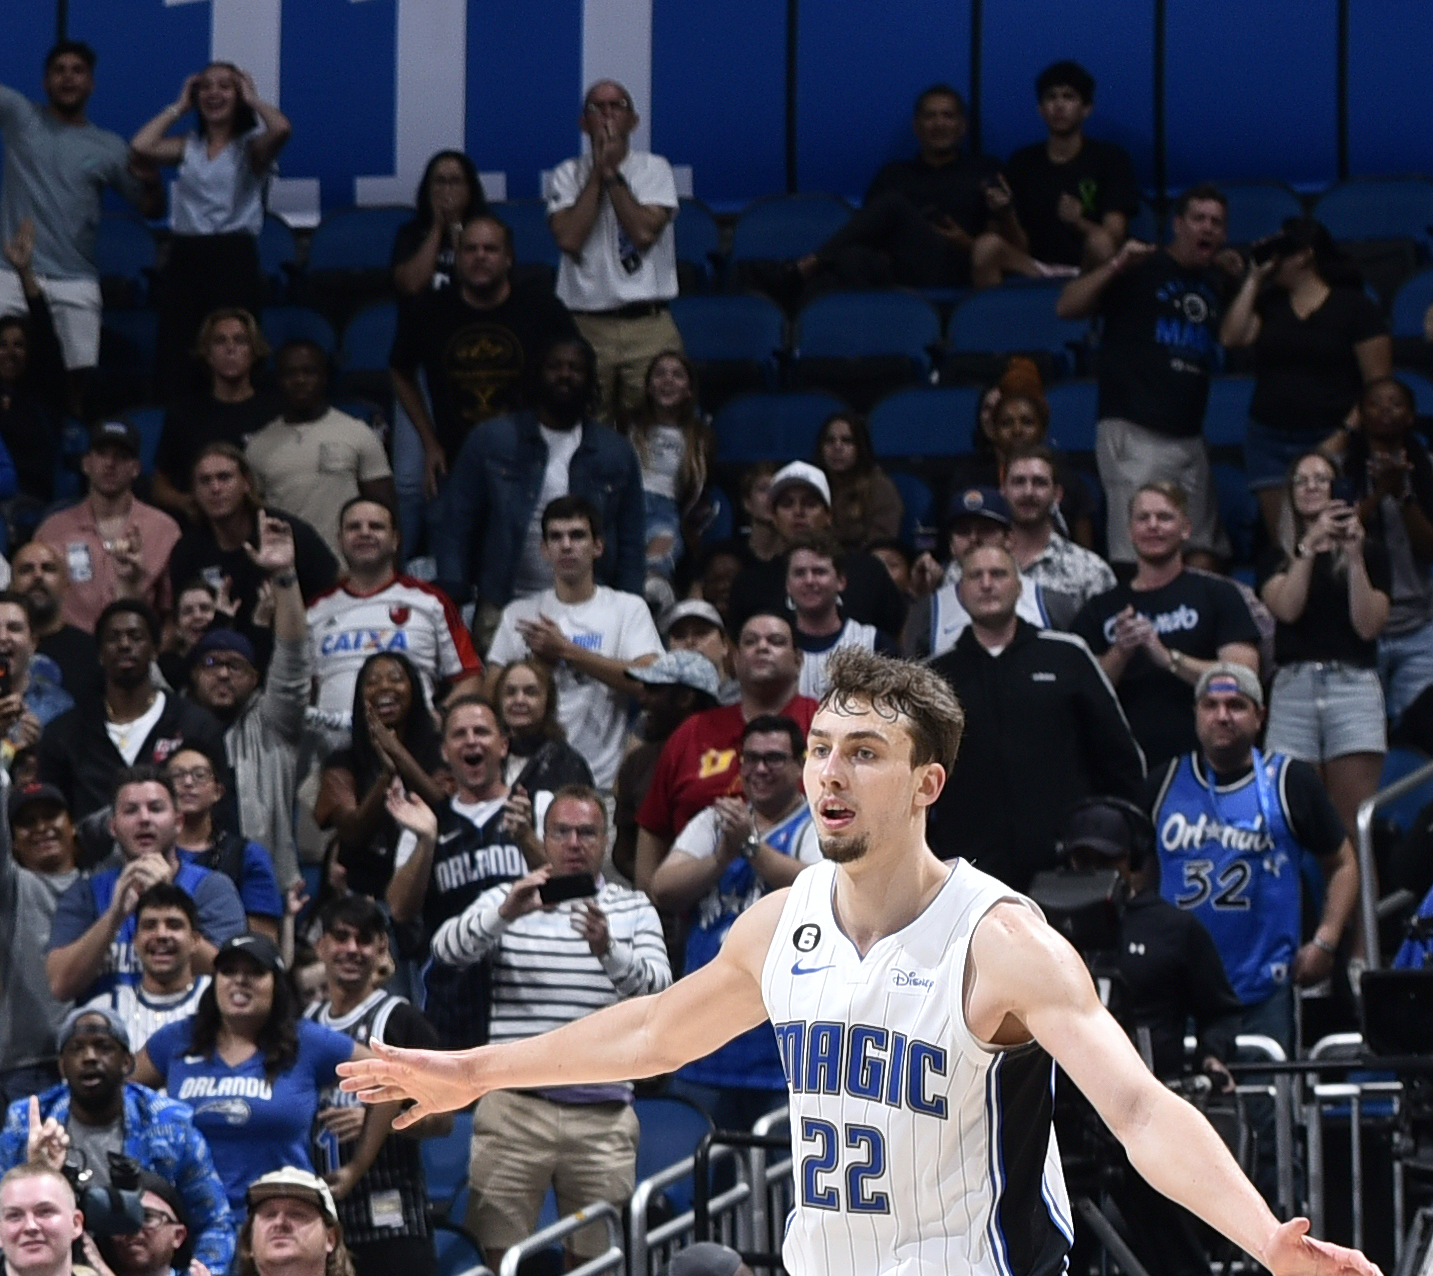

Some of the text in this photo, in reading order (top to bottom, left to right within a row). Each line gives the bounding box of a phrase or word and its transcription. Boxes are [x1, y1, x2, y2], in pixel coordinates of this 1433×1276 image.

[321, 629, 409, 655] CAIXA
[1174, 859, 1251, 912] 32
[178, 1076, 274, 1101] ORLANDO
[776, 1021, 948, 1120] MAGIC
[802, 1118, 890, 1214] 22
